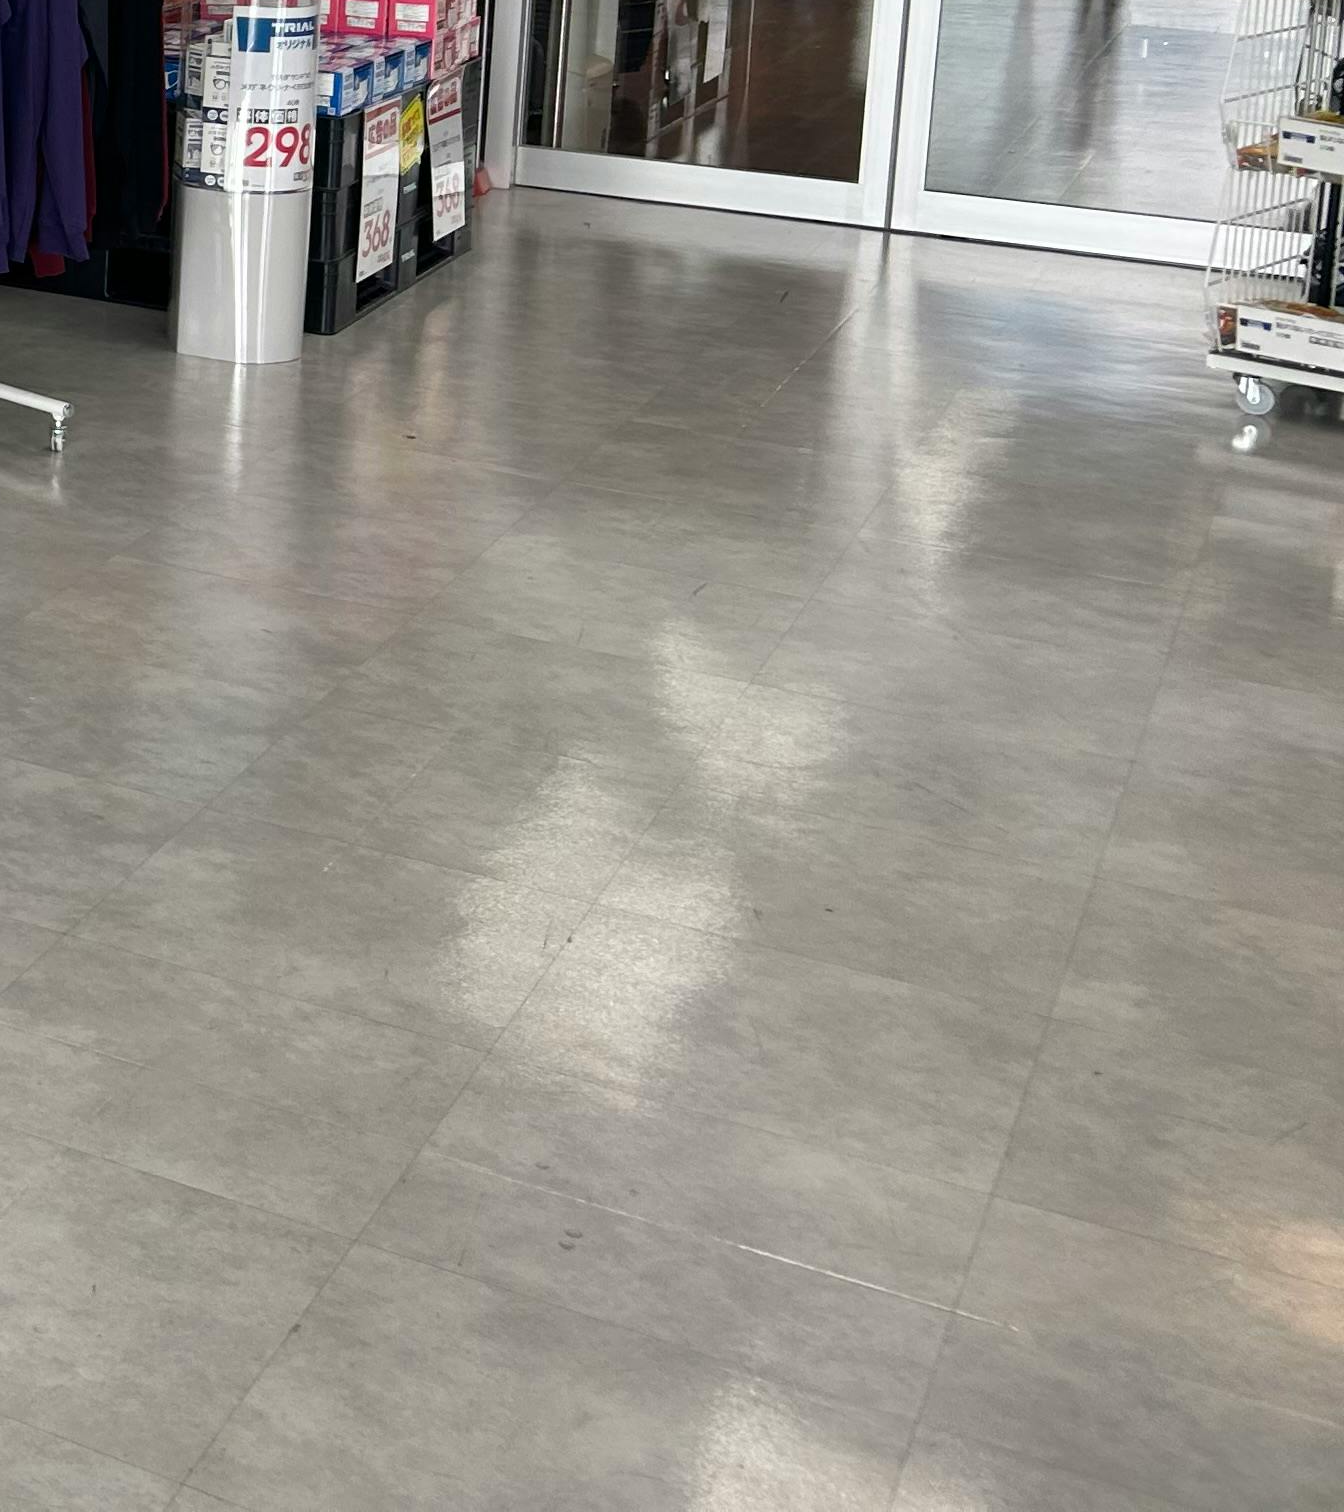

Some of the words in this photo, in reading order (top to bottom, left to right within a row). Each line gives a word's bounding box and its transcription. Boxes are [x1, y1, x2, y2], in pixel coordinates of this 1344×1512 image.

[271, 21, 315, 35] TRIAL
[243, 122, 312, 168] 298
[362, 208, 391, 259] 368
